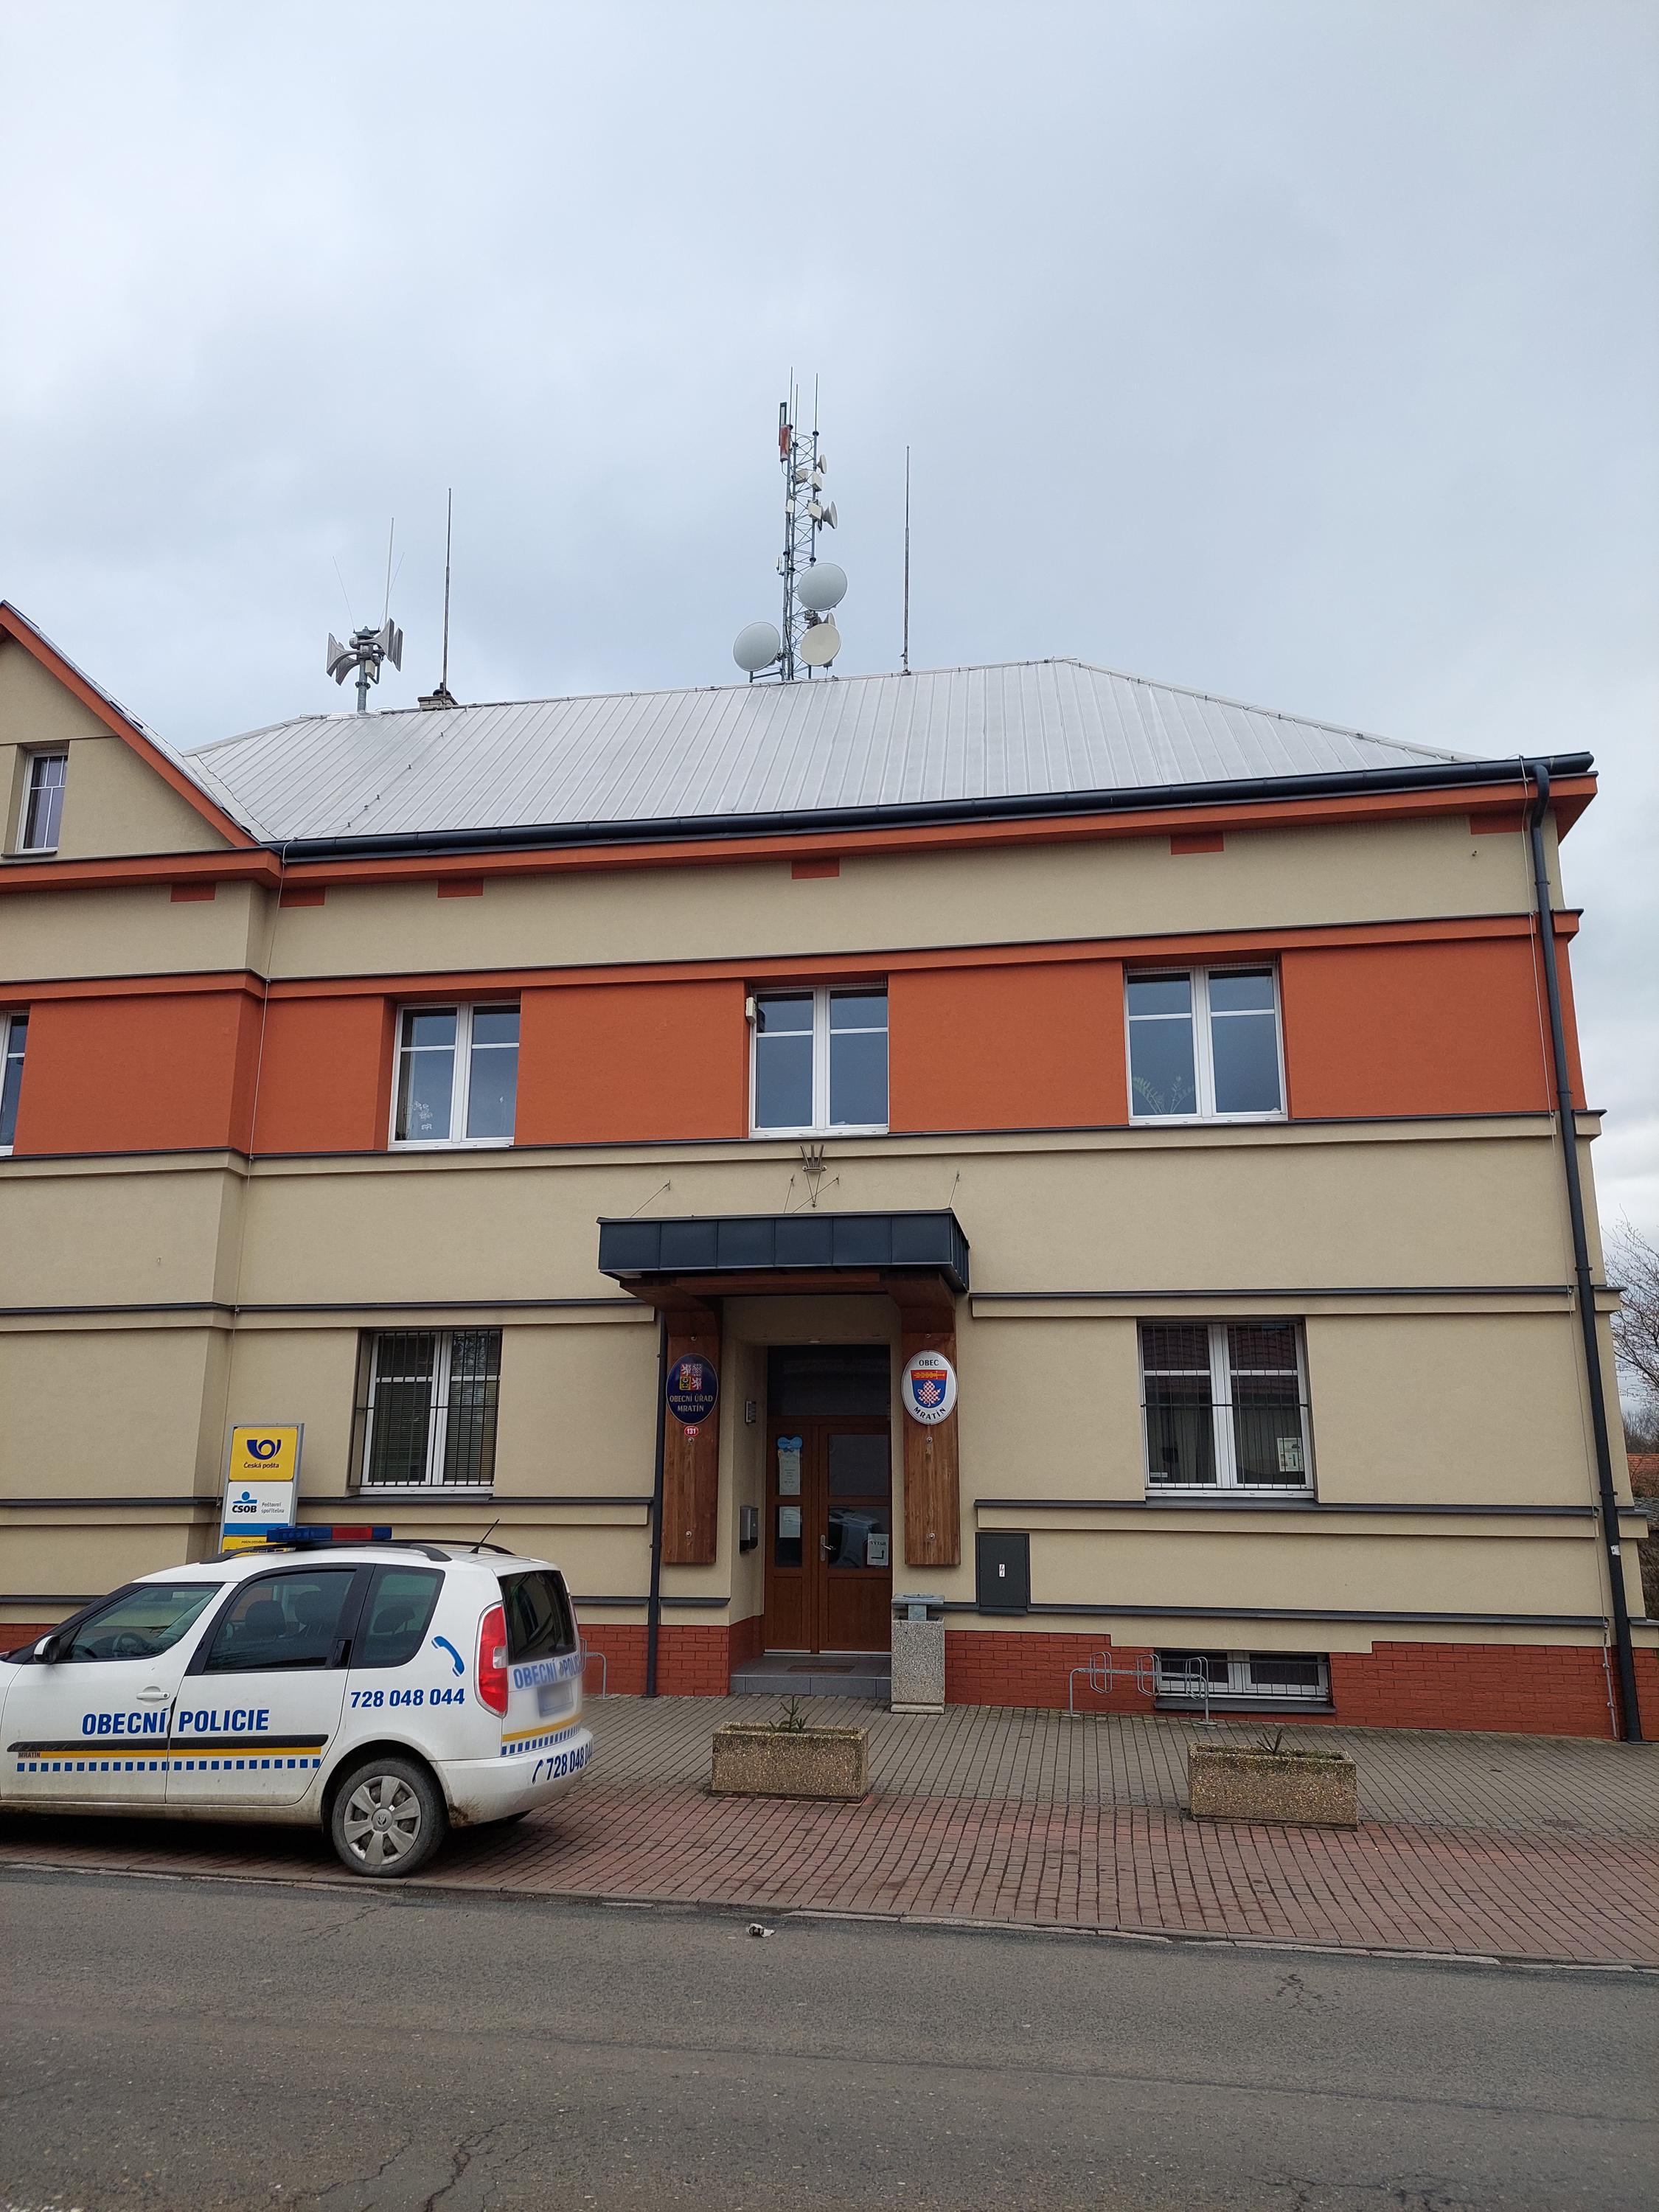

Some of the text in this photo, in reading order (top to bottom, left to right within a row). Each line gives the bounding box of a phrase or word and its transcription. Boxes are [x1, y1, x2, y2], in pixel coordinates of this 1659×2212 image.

[669, 1393, 713, 1402] OBECNÍ ÚŘAD
[677, 1403, 704, 1412] MRATÍN
[914, 1406, 947, 1420] MRATÍN
[232, 1503, 257, 1513] ČSOB
[512, 1659, 558, 1689] OBECNÍ
[350, 1688, 465, 1708] 728 048 044
[81, 1708, 270, 1736] OBECNÍ POLICIE
[546, 1753, 568, 1781] 728
[569, 1746, 585, 1773] 048
